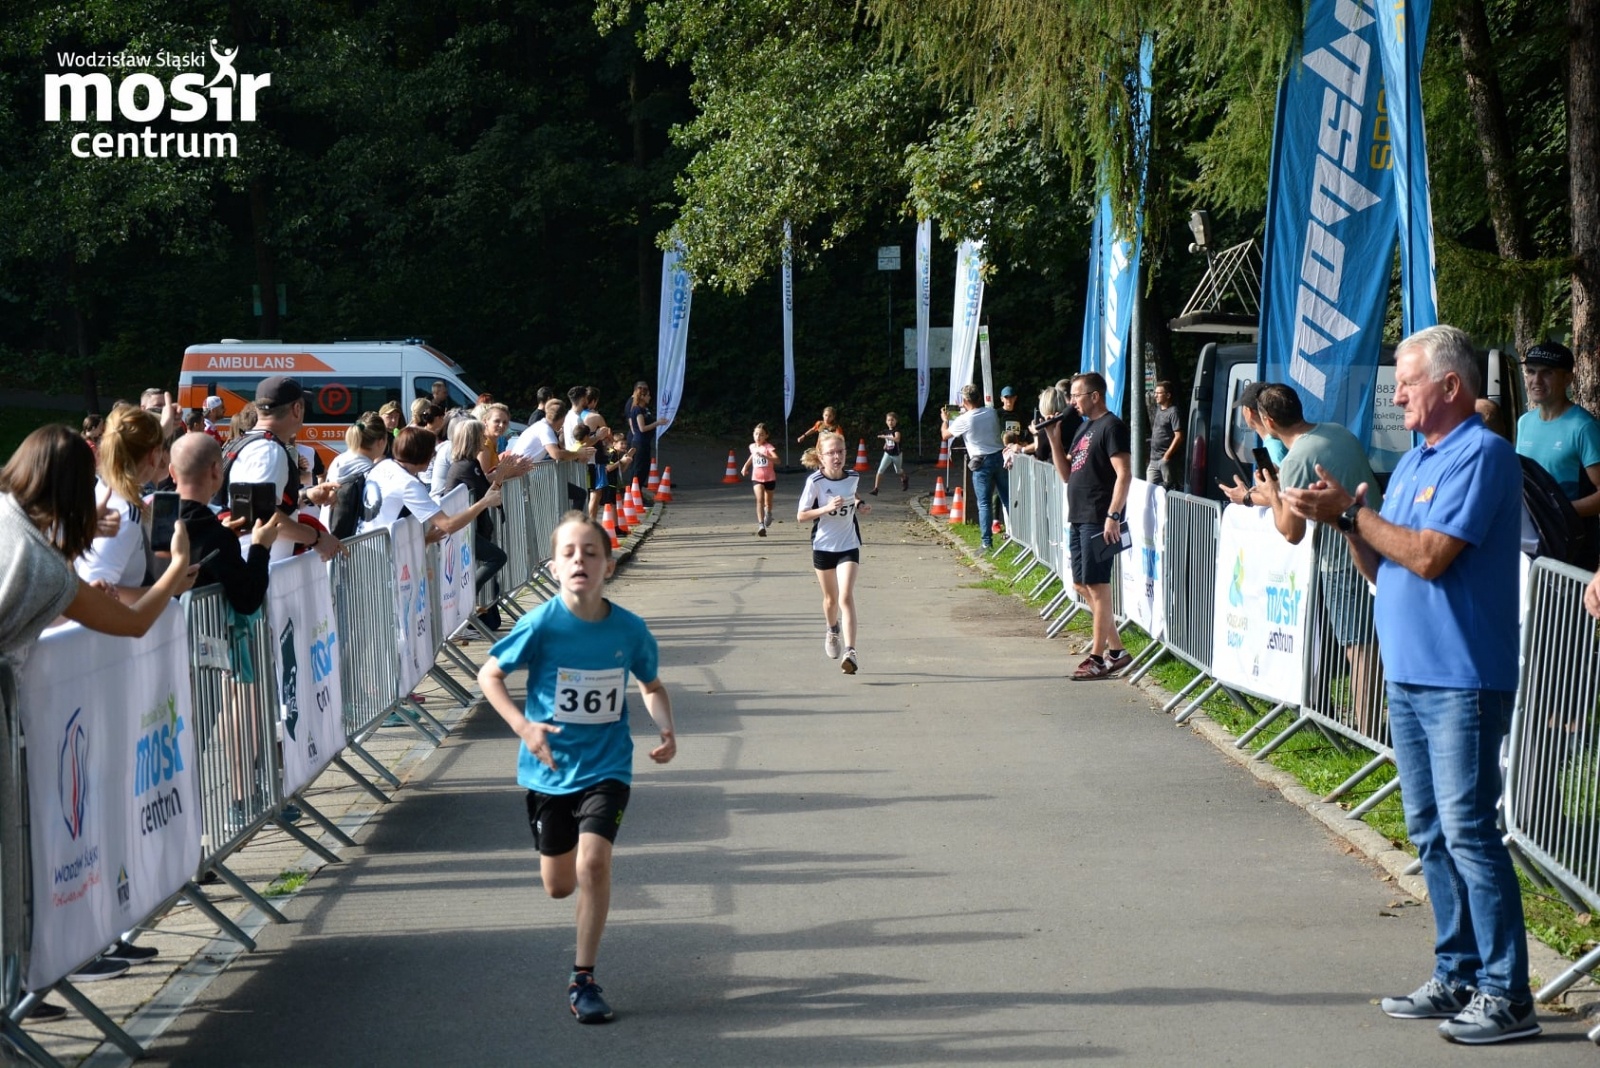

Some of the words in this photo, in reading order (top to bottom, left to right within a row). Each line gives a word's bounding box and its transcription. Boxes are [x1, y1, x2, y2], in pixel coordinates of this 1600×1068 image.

[207, 356, 295, 369] AMBULANS
[1376, 384, 1396, 394] 883
[322, 430, 335, 438] 513
[336, 430, 346, 438] 51
[1266, 627, 1294, 654] entrum
[559, 687, 617, 714] 361
[134, 715, 185, 797] mosr
